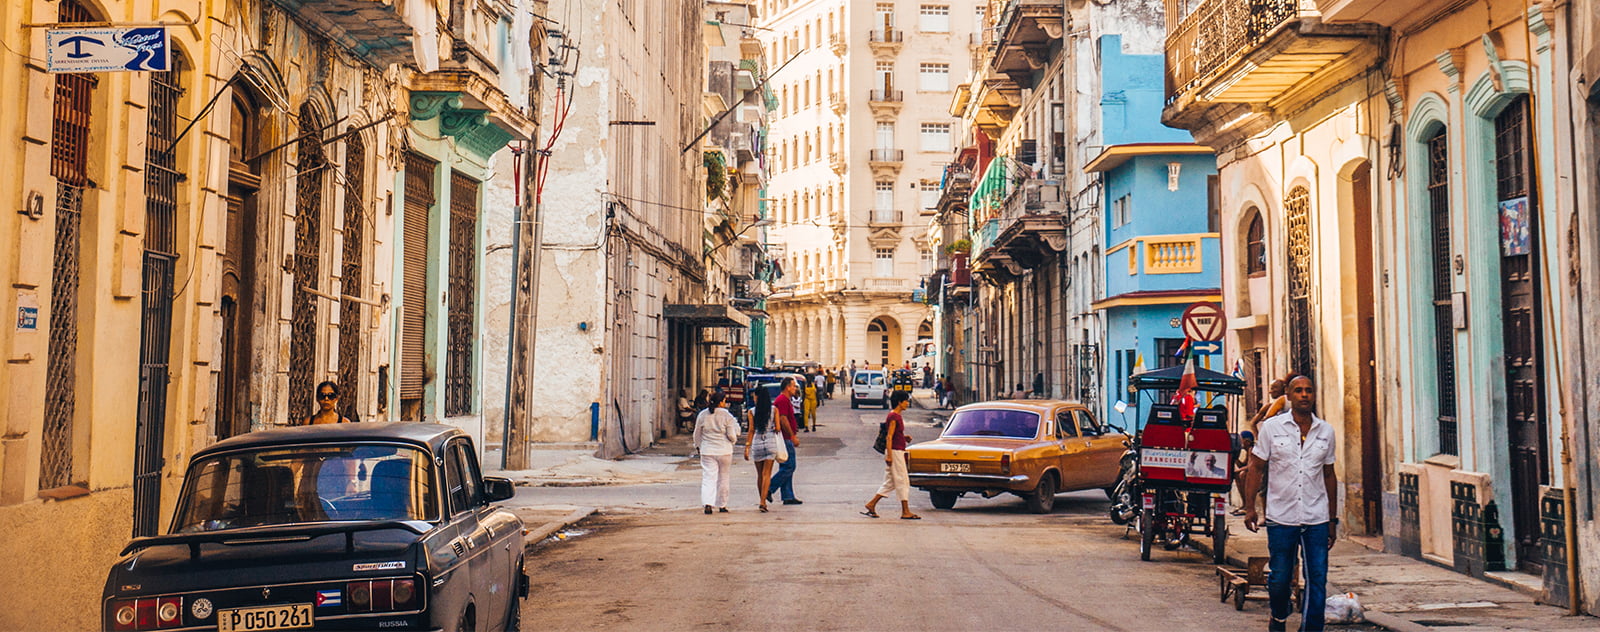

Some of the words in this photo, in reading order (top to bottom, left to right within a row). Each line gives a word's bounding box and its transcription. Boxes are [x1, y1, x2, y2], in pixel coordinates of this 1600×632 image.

[231, 612, 241, 631] P
[245, 610, 276, 630] 050
[280, 607, 311, 627] 261
[379, 620, 408, 628] RUSSIA
